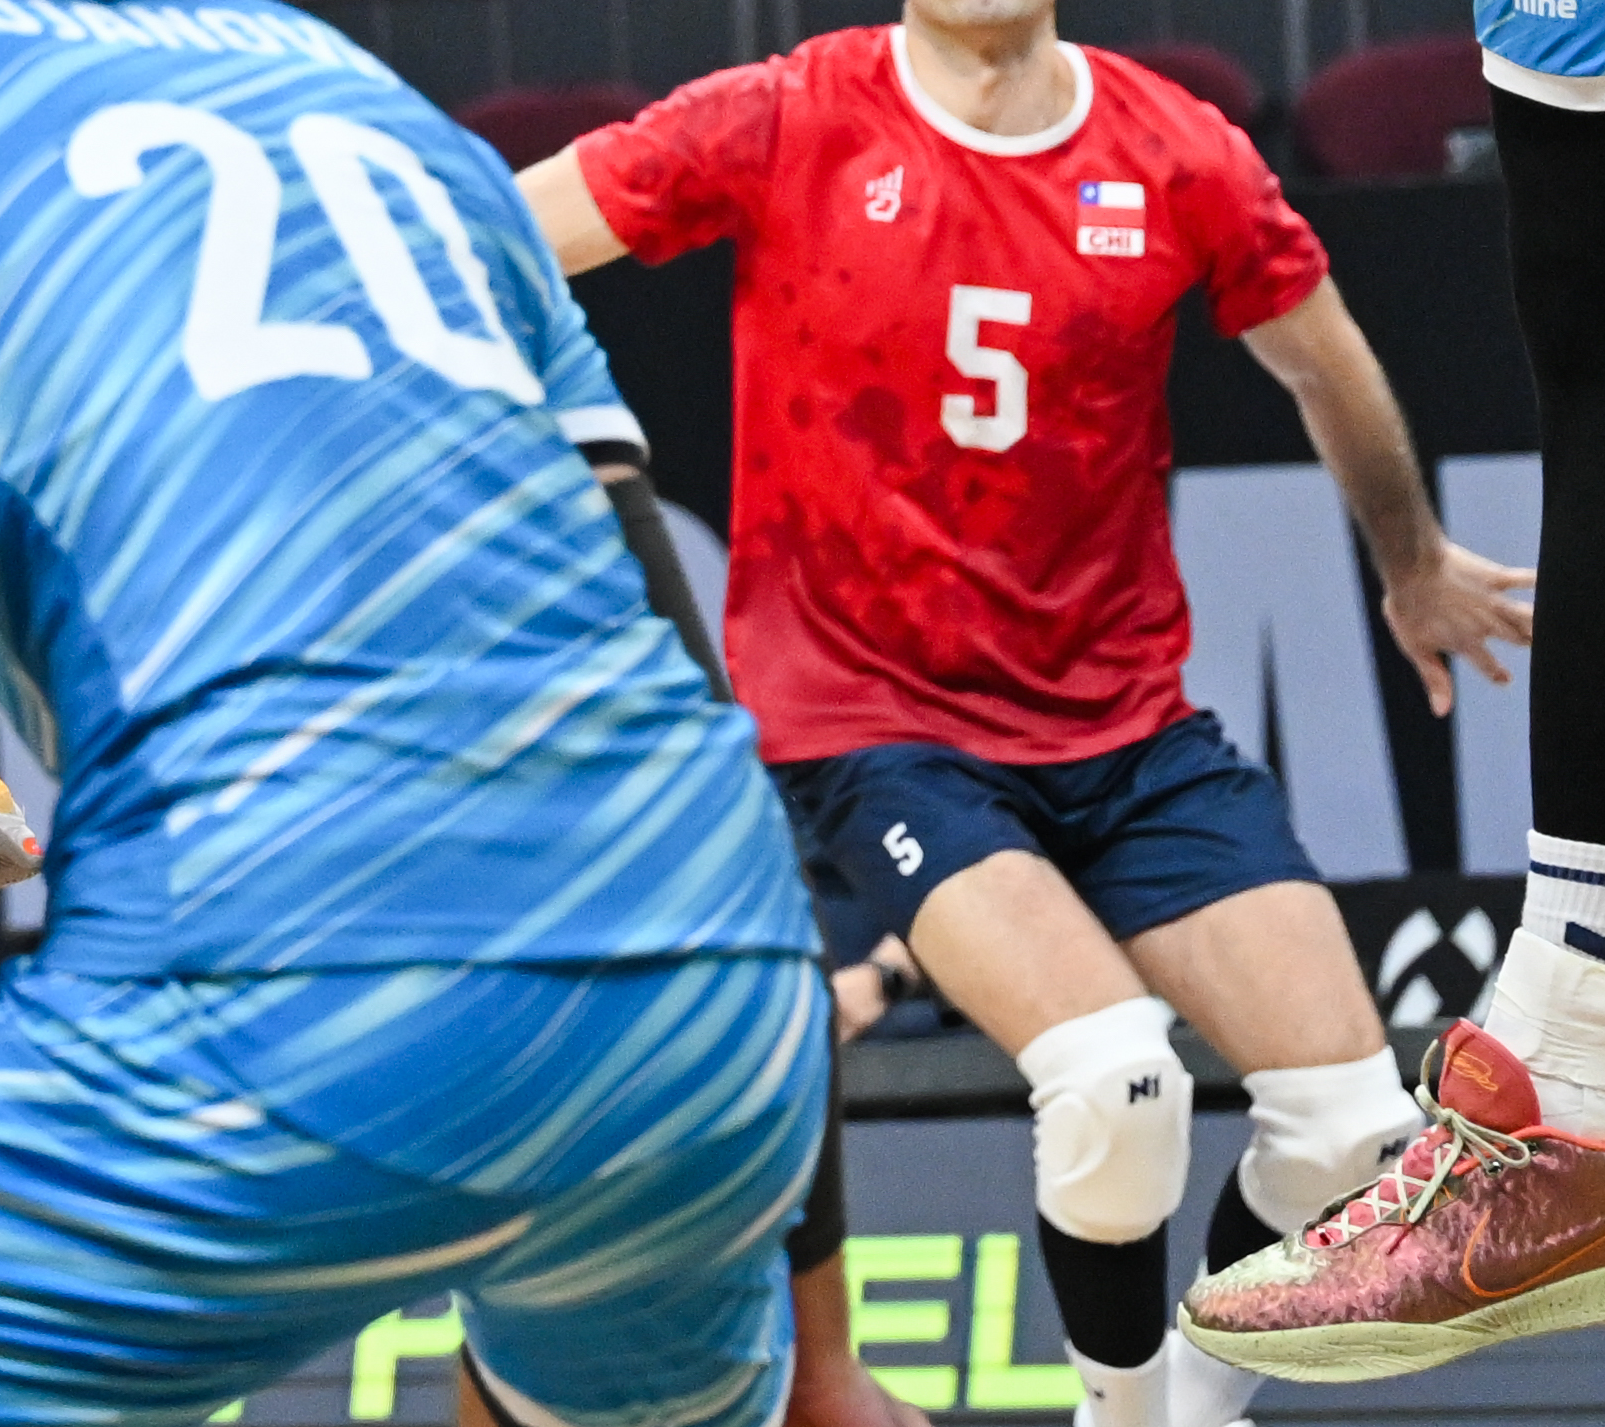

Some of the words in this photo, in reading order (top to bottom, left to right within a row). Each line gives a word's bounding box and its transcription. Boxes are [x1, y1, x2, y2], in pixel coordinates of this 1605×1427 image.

[66, 100, 547, 408] 20
[940, 284, 1033, 453] 5
[881, 821, 924, 877] 5
